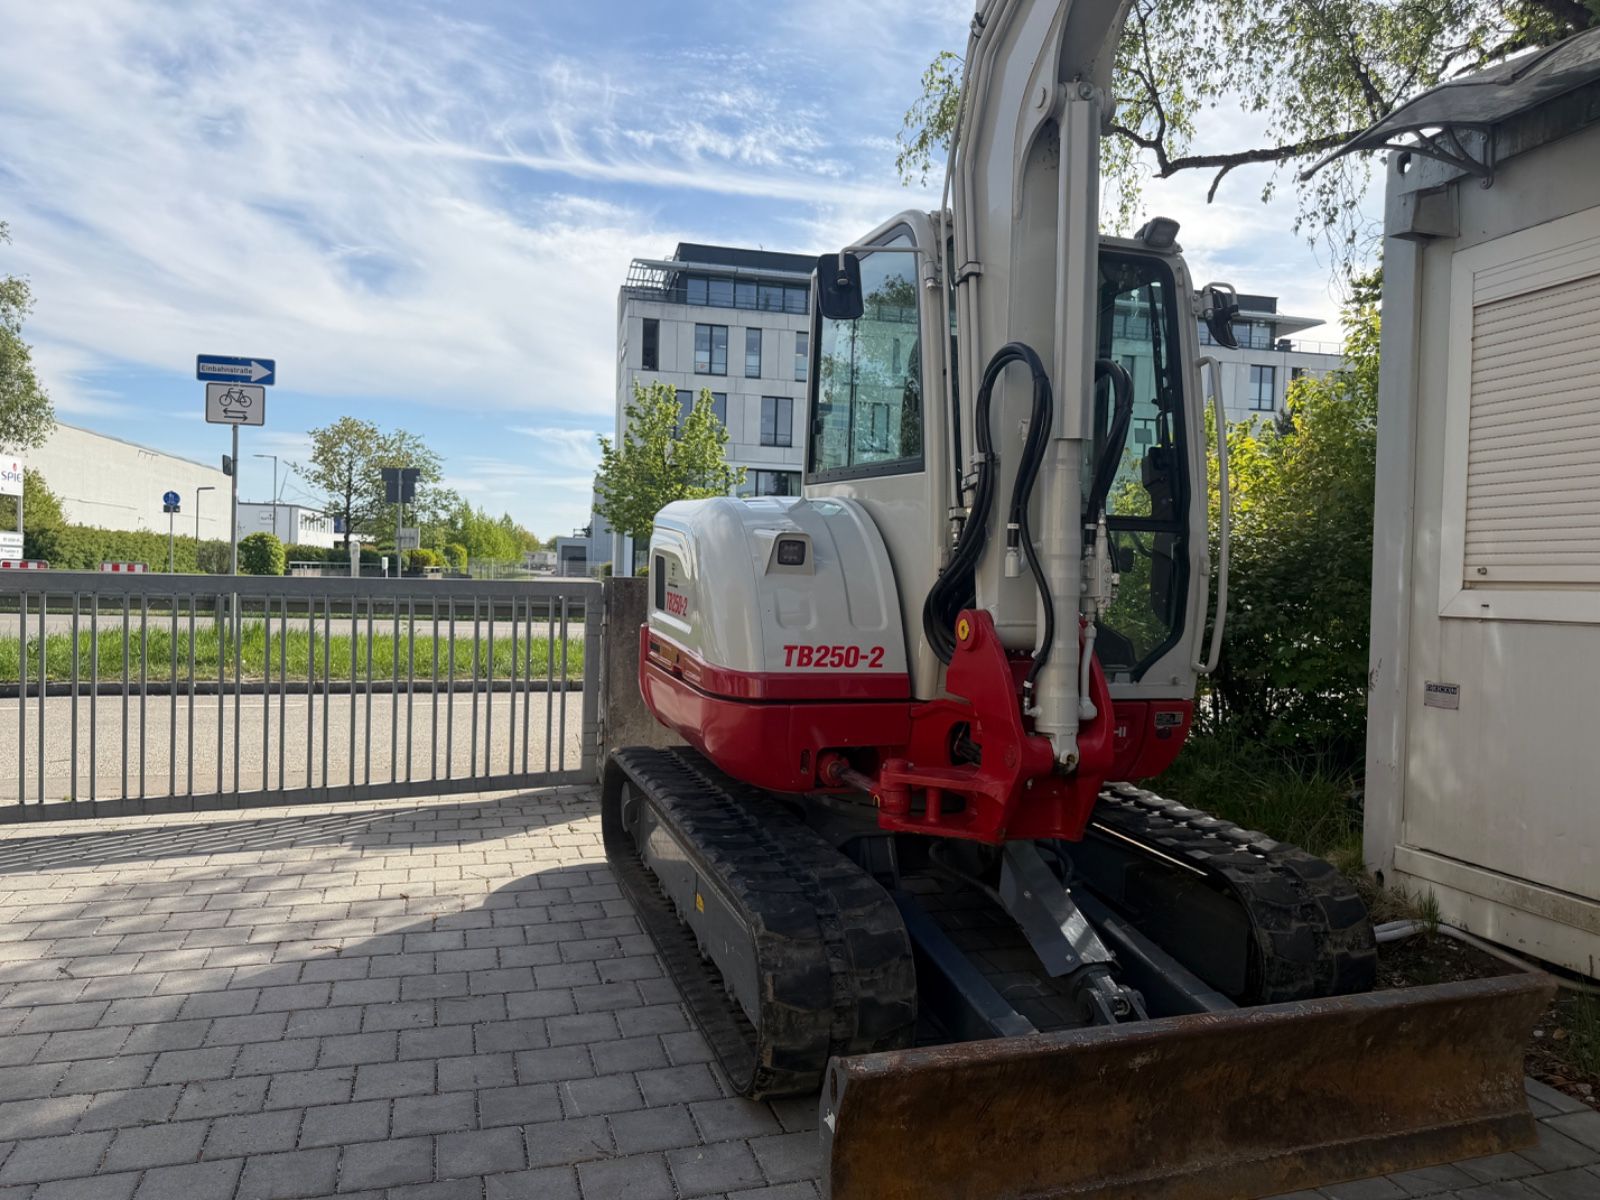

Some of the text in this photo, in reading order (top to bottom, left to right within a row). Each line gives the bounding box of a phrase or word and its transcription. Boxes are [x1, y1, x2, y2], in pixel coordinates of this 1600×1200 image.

[201, 364, 253, 375] Einbahnstraße
[1, 468, 22, 483] SPIE
[783, 644, 885, 668] TB250-2
